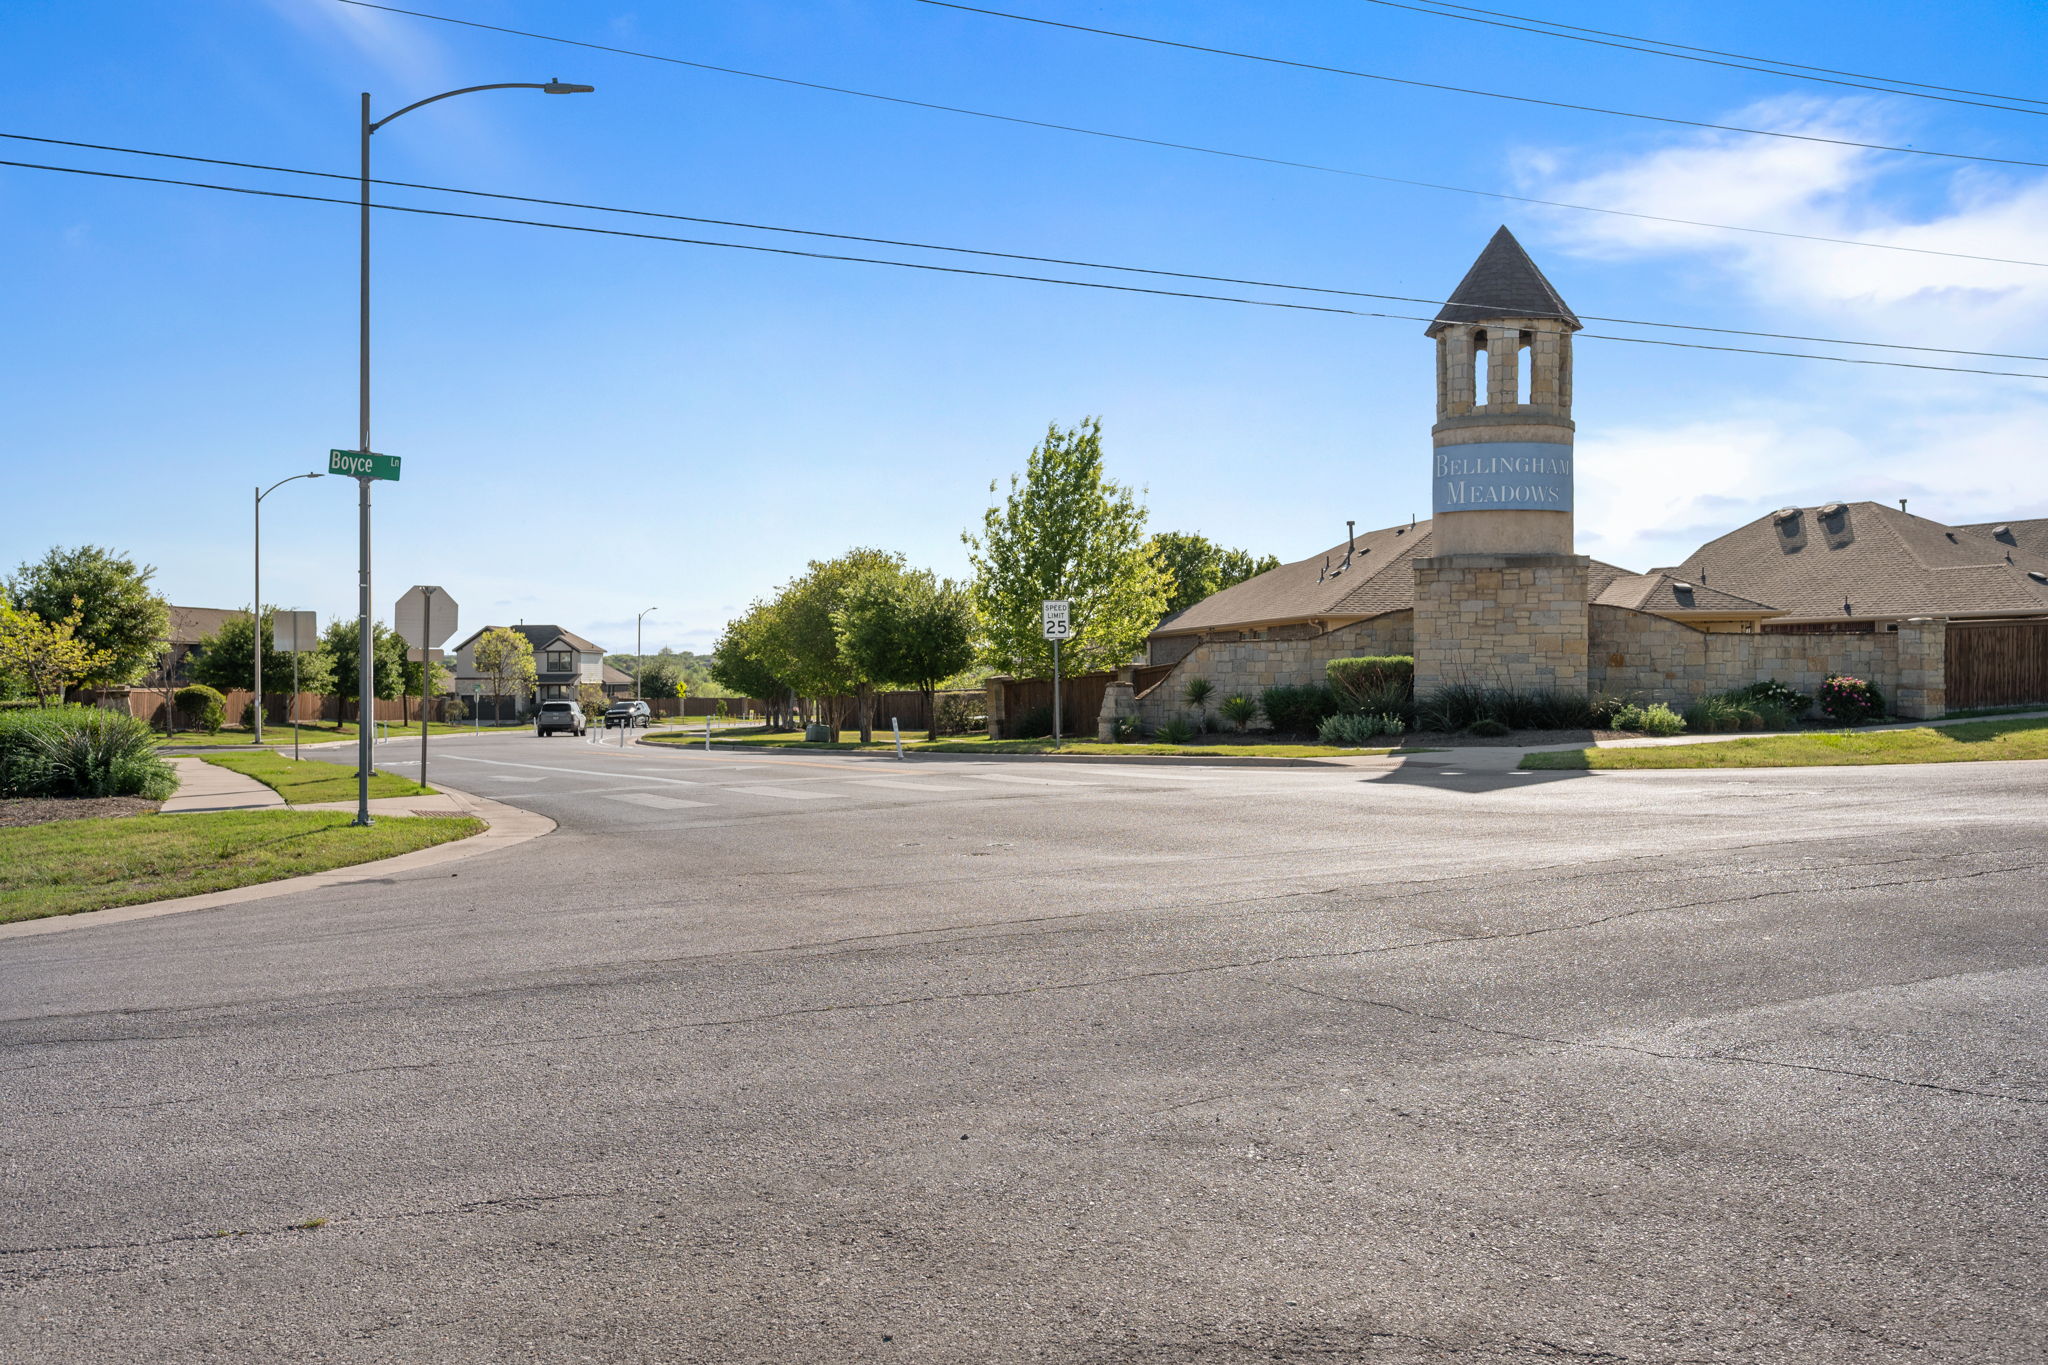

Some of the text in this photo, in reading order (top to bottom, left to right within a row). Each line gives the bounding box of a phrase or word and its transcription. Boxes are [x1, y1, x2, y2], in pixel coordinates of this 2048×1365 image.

[331, 451, 400, 475] Boyce Ln
[1436, 454, 1570, 478] BELLINGHAM
[1447, 480, 1560, 505] MEADOWS
[1046, 620, 1067, 634] 25
